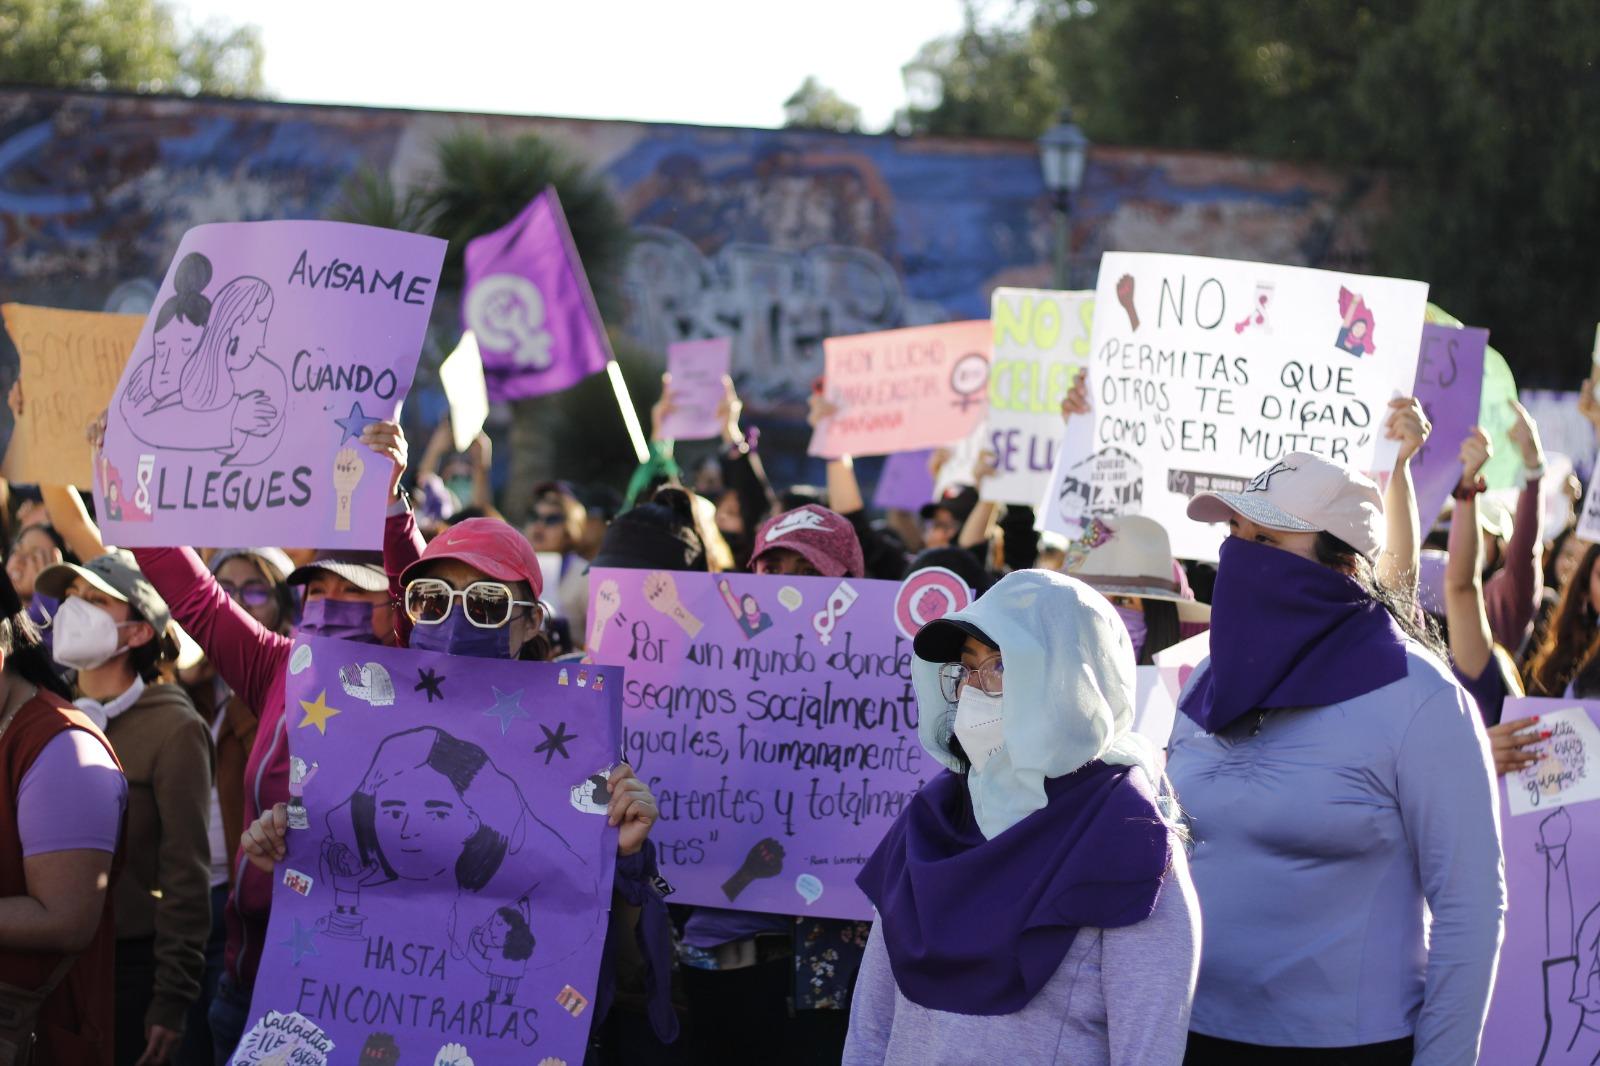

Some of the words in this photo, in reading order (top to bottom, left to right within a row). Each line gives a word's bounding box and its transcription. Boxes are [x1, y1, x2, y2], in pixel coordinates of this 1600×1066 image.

[288, 249, 431, 305] AVÍSAME
[1157, 275, 1226, 330] NO
[993, 296, 1060, 350] NO
[1072, 299, 1094, 357] S
[292, 349, 397, 400] CUANDO
[1099, 337, 1249, 386] PERMITAS
[1281, 361, 1355, 396] QUE
[1420, 335, 1460, 388] ES
[1102, 375, 1170, 412] OTROS
[1195, 386, 1235, 415] TE
[1261, 395, 1371, 431] DIGAN
[1099, 415, 1146, 446] COMO
[157, 465, 312, 512] LLEGUES
[686, 643, 723, 670] un
[732, 633, 815, 682] mundo
[827, 632, 912, 680] donde
[623, 680, 736, 719] seamos
[747, 680, 919, 732] socialment
[738, 723, 922, 776] humanamente
[648, 776, 765, 825] ferentes
[774, 789, 796, 836] y
[658, 829, 719, 866] res"
[364, 934, 446, 980] HASTA
[295, 978, 540, 1048] ENCONTRARLAS
